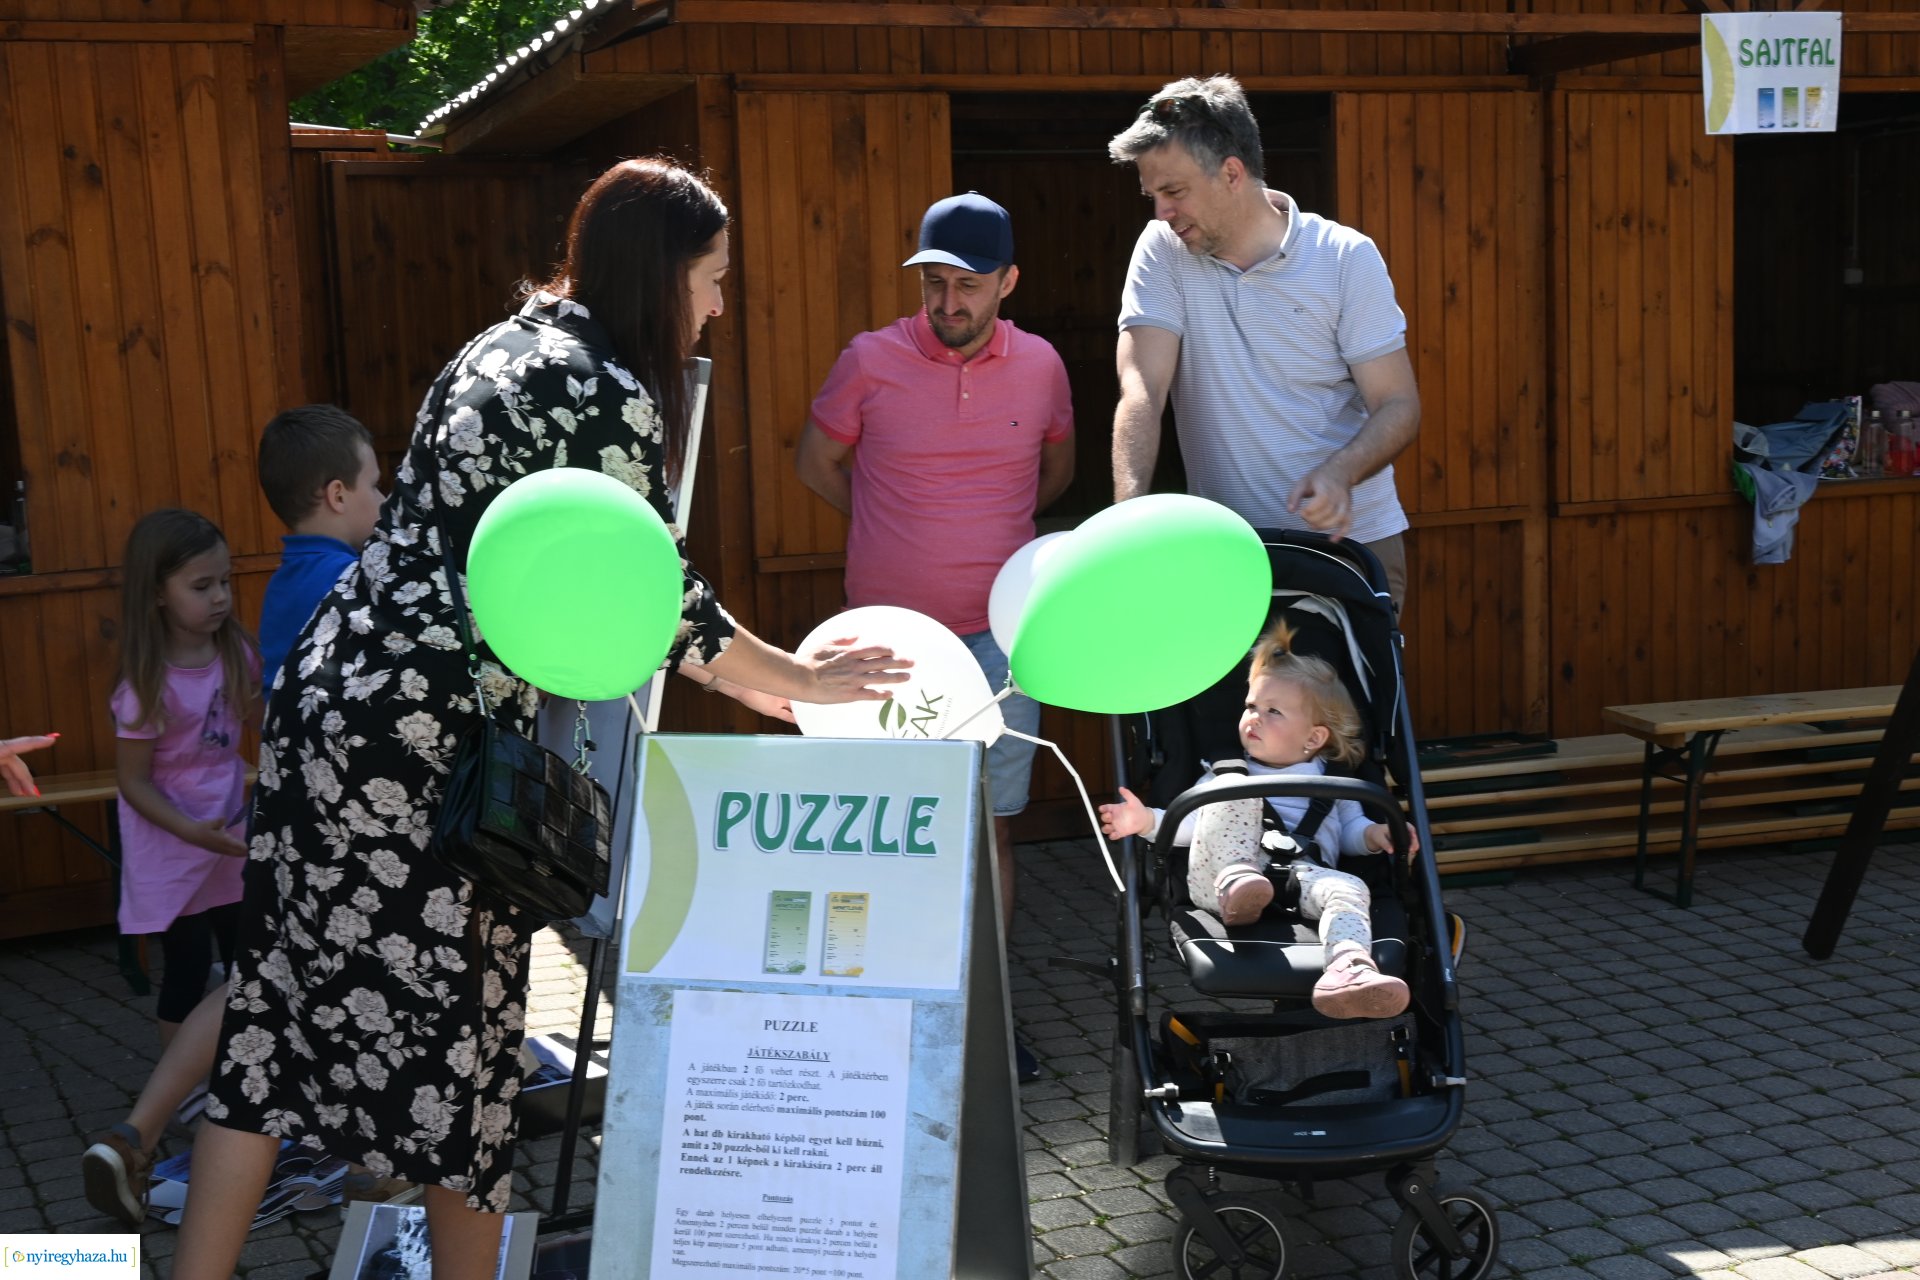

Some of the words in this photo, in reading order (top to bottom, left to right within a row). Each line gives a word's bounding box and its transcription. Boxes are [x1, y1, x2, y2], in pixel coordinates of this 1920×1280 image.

[1738, 37, 1836, 68] SAJTFAL
[714, 790, 941, 857] PUZZLE
[764, 1019, 818, 1033] PUZZLE
[747, 1048, 830, 1061] JÁTÉKSZABÁLY
[688, 1063, 696, 1071] A
[701, 1064, 737, 1074] játékban
[771, 1067, 792, 1076] vehet
[828, 1070, 835, 1078] A
[687, 1077, 726, 1086] egyszerre
[729, 1077, 746, 1086] csak
[750, 1078, 755, 1086] 2
[687, 1088, 694, 1096] A
[696, 1089, 738, 1097] maximális
[787, 1094, 809, 1103] perc.
[684, 1113, 706, 1122] pont.
[693, 1101, 714, 1110] játék
[717, 1102, 739, 1111] során
[741, 1103, 775, 1112] elérhető
[777, 1106, 822, 1116] maximális
[824, 1109, 867, 1119] pontszám
[870, 1110, 886, 1119] 100
[694, 1129, 708, 1137] hat
[712, 1129, 723, 1138] db
[727, 1131, 771, 1140] kirakható
[809, 1135, 832, 1146] egyet
[836, 1137, 852, 1146] kell
[682, 1141, 701, 1149] amit
[712, 1142, 722, 1150] 20
[772, 1145, 781, 1154] ki
[784, 1146, 800, 1155] kell
[802, 1148, 829, 1157] rakni.
[681, 1153, 709, 1163] Ennek
[737, 1156, 769, 1167] képnek
[784, 1159, 832, 1170] kirakására
[837, 1162, 842, 1170] 2
[846, 1164, 867, 1172] perc
[871, 1163, 882, 1173] áll
[680, 1166, 742, 1178] rendelkezésre.
[676, 1208, 688, 1216] Egy
[694, 1229, 706, 1237] 100
